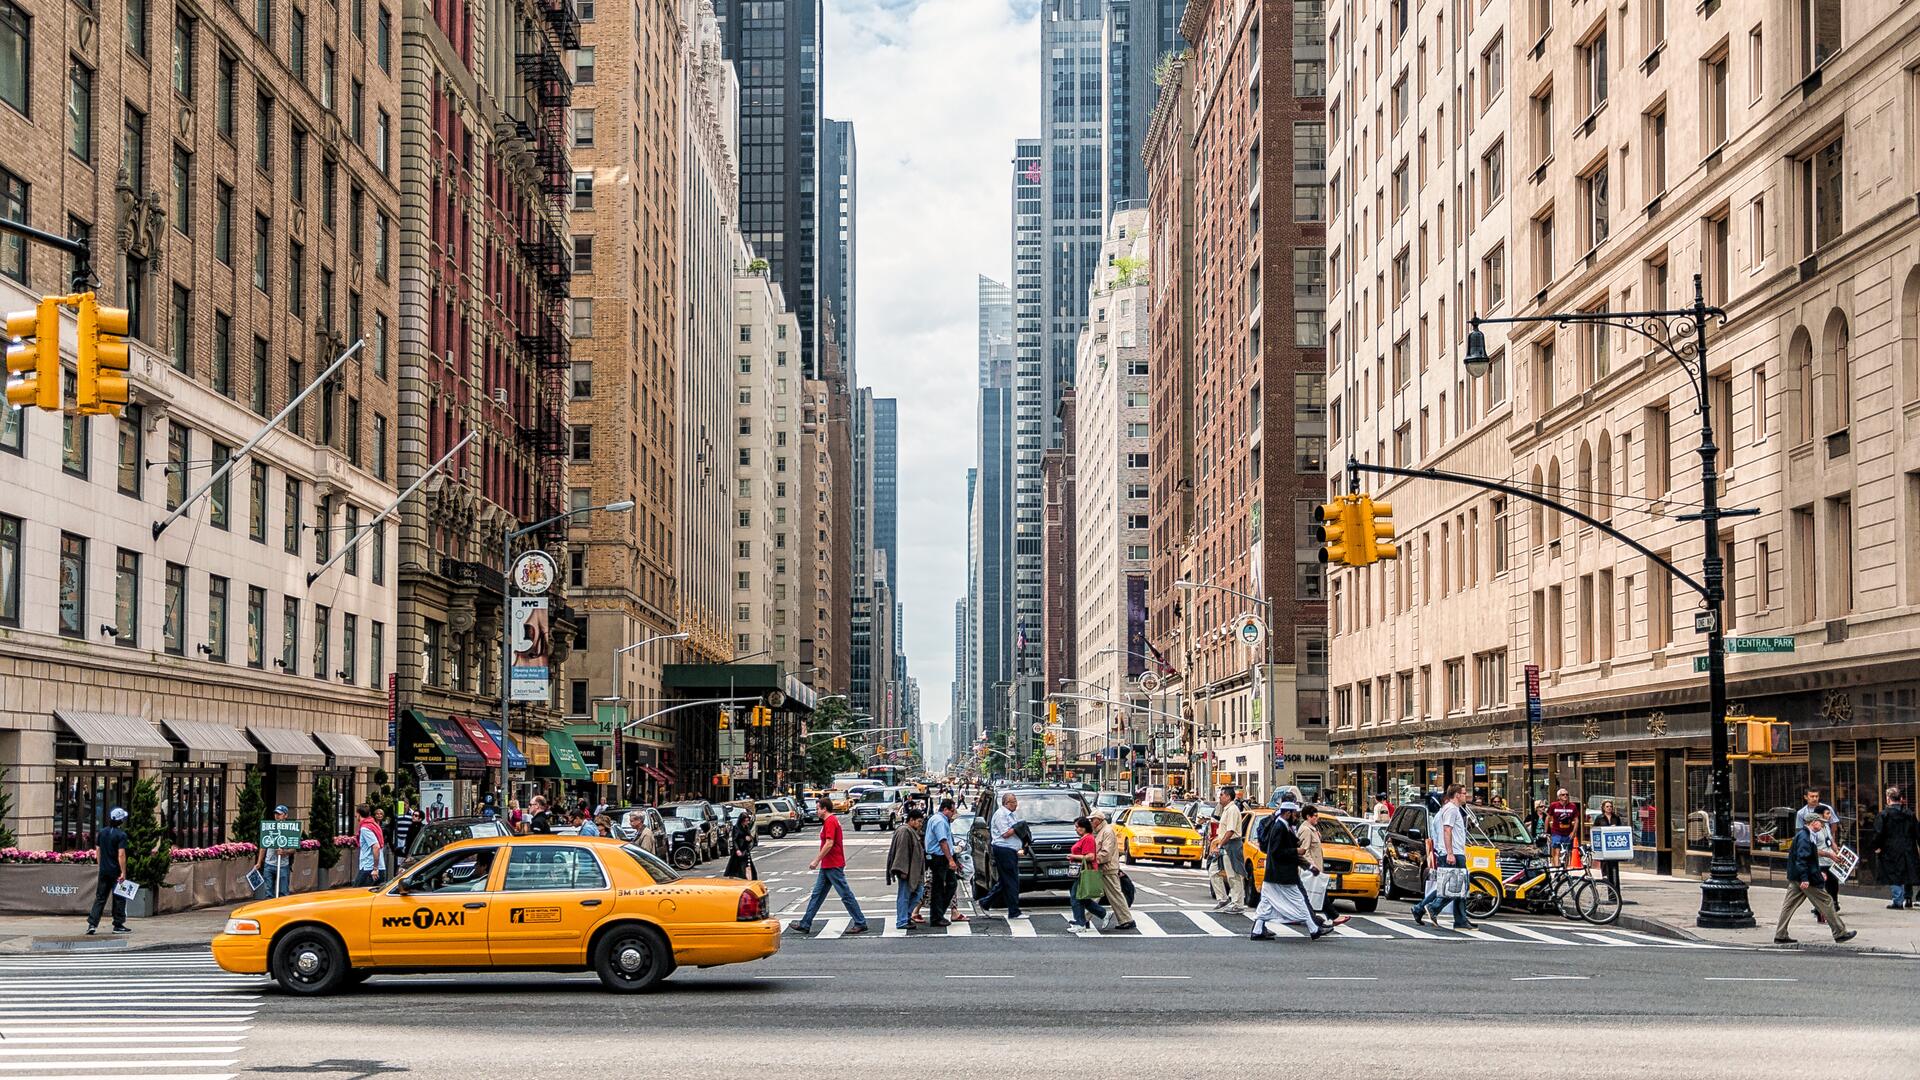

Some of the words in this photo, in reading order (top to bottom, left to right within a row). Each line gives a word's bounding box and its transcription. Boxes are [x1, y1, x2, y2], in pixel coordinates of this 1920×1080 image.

[1737, 638, 1771, 648] CENTRAL
[1773, 637, 1793, 647] PARK
[113, 746, 136, 758] MARKET
[262, 822, 276, 832] BIKE
[277, 822, 299, 832] RENTAL
[41, 886, 79, 894] MARKET
[382, 917, 411, 927] NYC
[413, 907, 464, 929] TAXI
